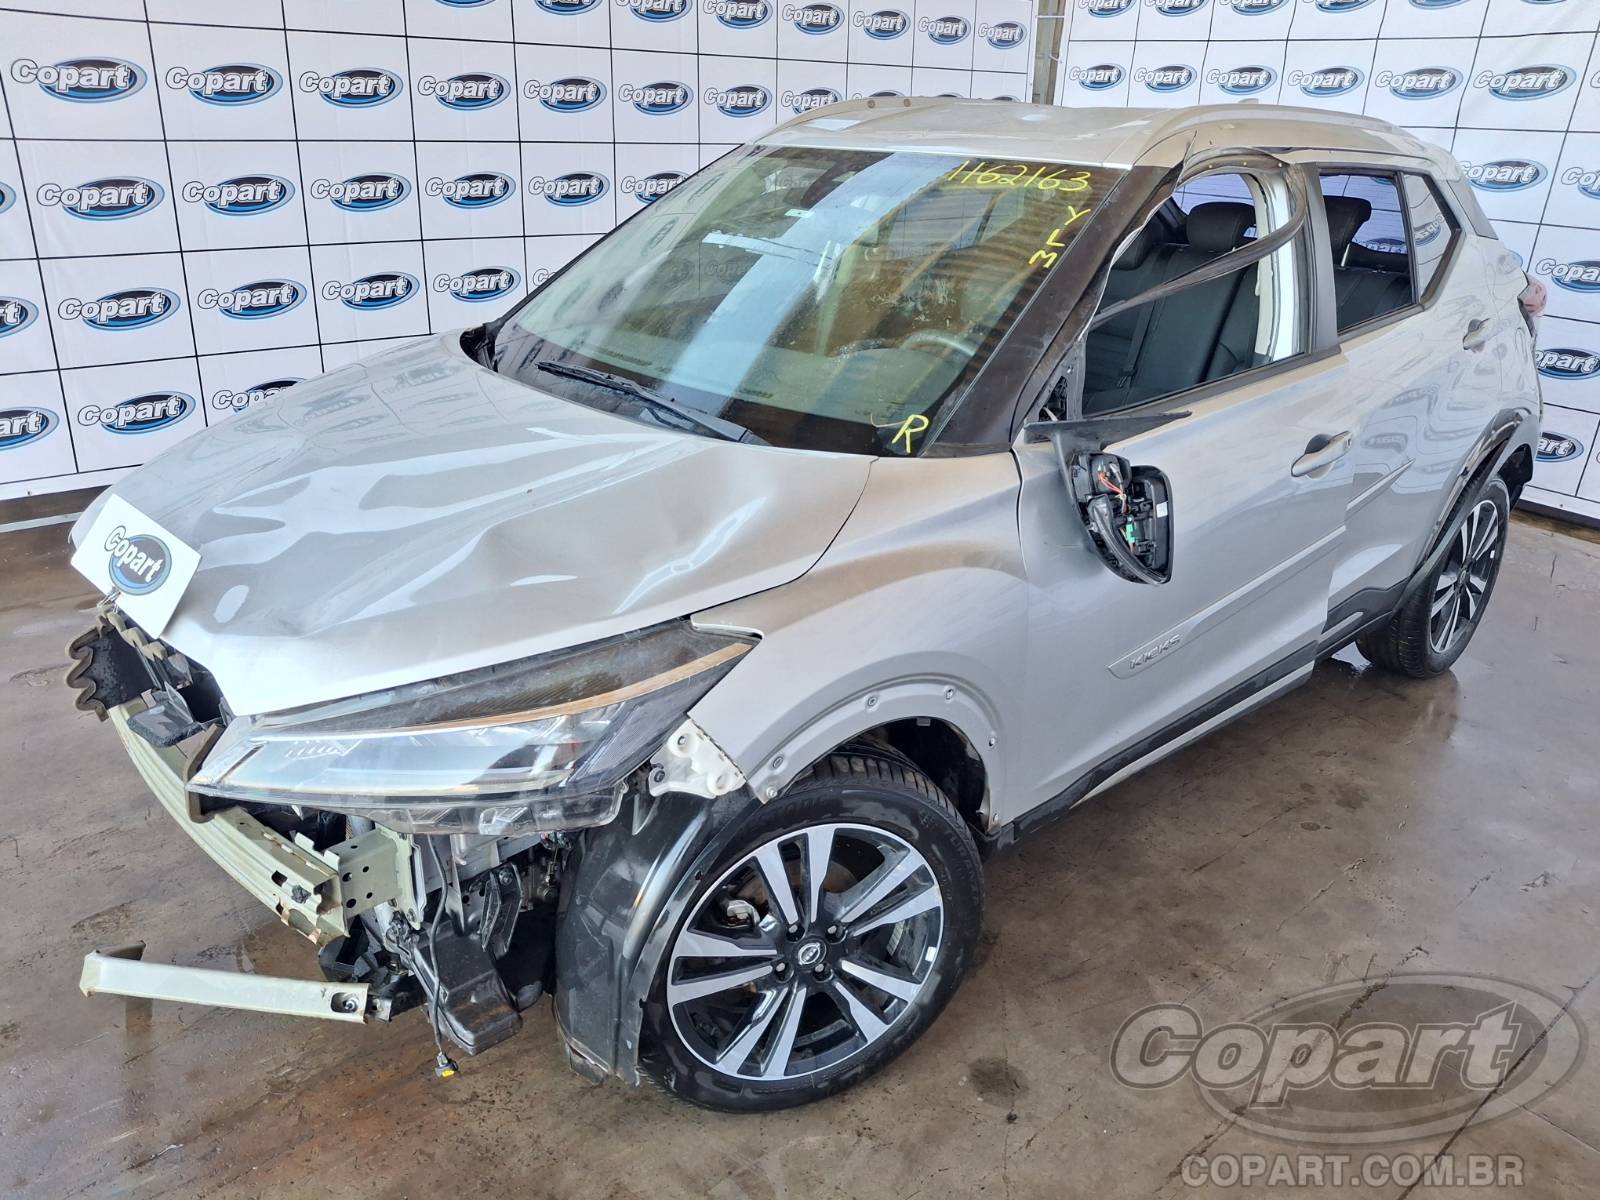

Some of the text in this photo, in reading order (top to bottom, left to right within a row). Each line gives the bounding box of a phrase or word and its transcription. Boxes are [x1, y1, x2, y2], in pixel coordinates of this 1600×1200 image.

[703, 0, 766, 20] Copart
[782, 3, 838, 27] Copart
[853, 11, 905, 33] Copart
[918, 17, 966, 38] Copart
[978, 23, 1022, 43] Copart
[11, 59, 132, 92] Copart
[166, 66, 271, 94] Copart
[299, 71, 392, 99] Copart
[1069, 66, 1118, 84] Copart
[1134, 67, 1191, 86] Copart
[1206, 69, 1269, 88] Copart
[1288, 70, 1356, 89] Copart
[1375, 70, 1453, 92] Copart
[1473, 69, 1564, 93] Copart
[418, 75, 501, 101] Copart
[524, 80, 597, 103] Copart
[618, 84, 684, 106] Copart
[704, 88, 766, 110] Copart
[425, 176, 507, 200] Copart
[528, 176, 602, 197] Copart
[948, 160, 1092, 192] 1162163
[37, 180, 151, 211] Copart
[182, 179, 283, 208] Copart
[311, 177, 400, 204] Copart
[1535, 258, 1600, 282] Copa
[322, 275, 409, 301] Copart
[433, 271, 512, 294] Copart
[58, 292, 167, 323] Copart
[197, 283, 295, 311] Copart
[1535, 349, 1600, 374] opart
[0, 410, 42, 435] art
[78, 396, 182, 428] Copart
[891, 414, 929, 454] R
[1538, 437, 1574, 456] art
[104, 525, 164, 583] Copart
